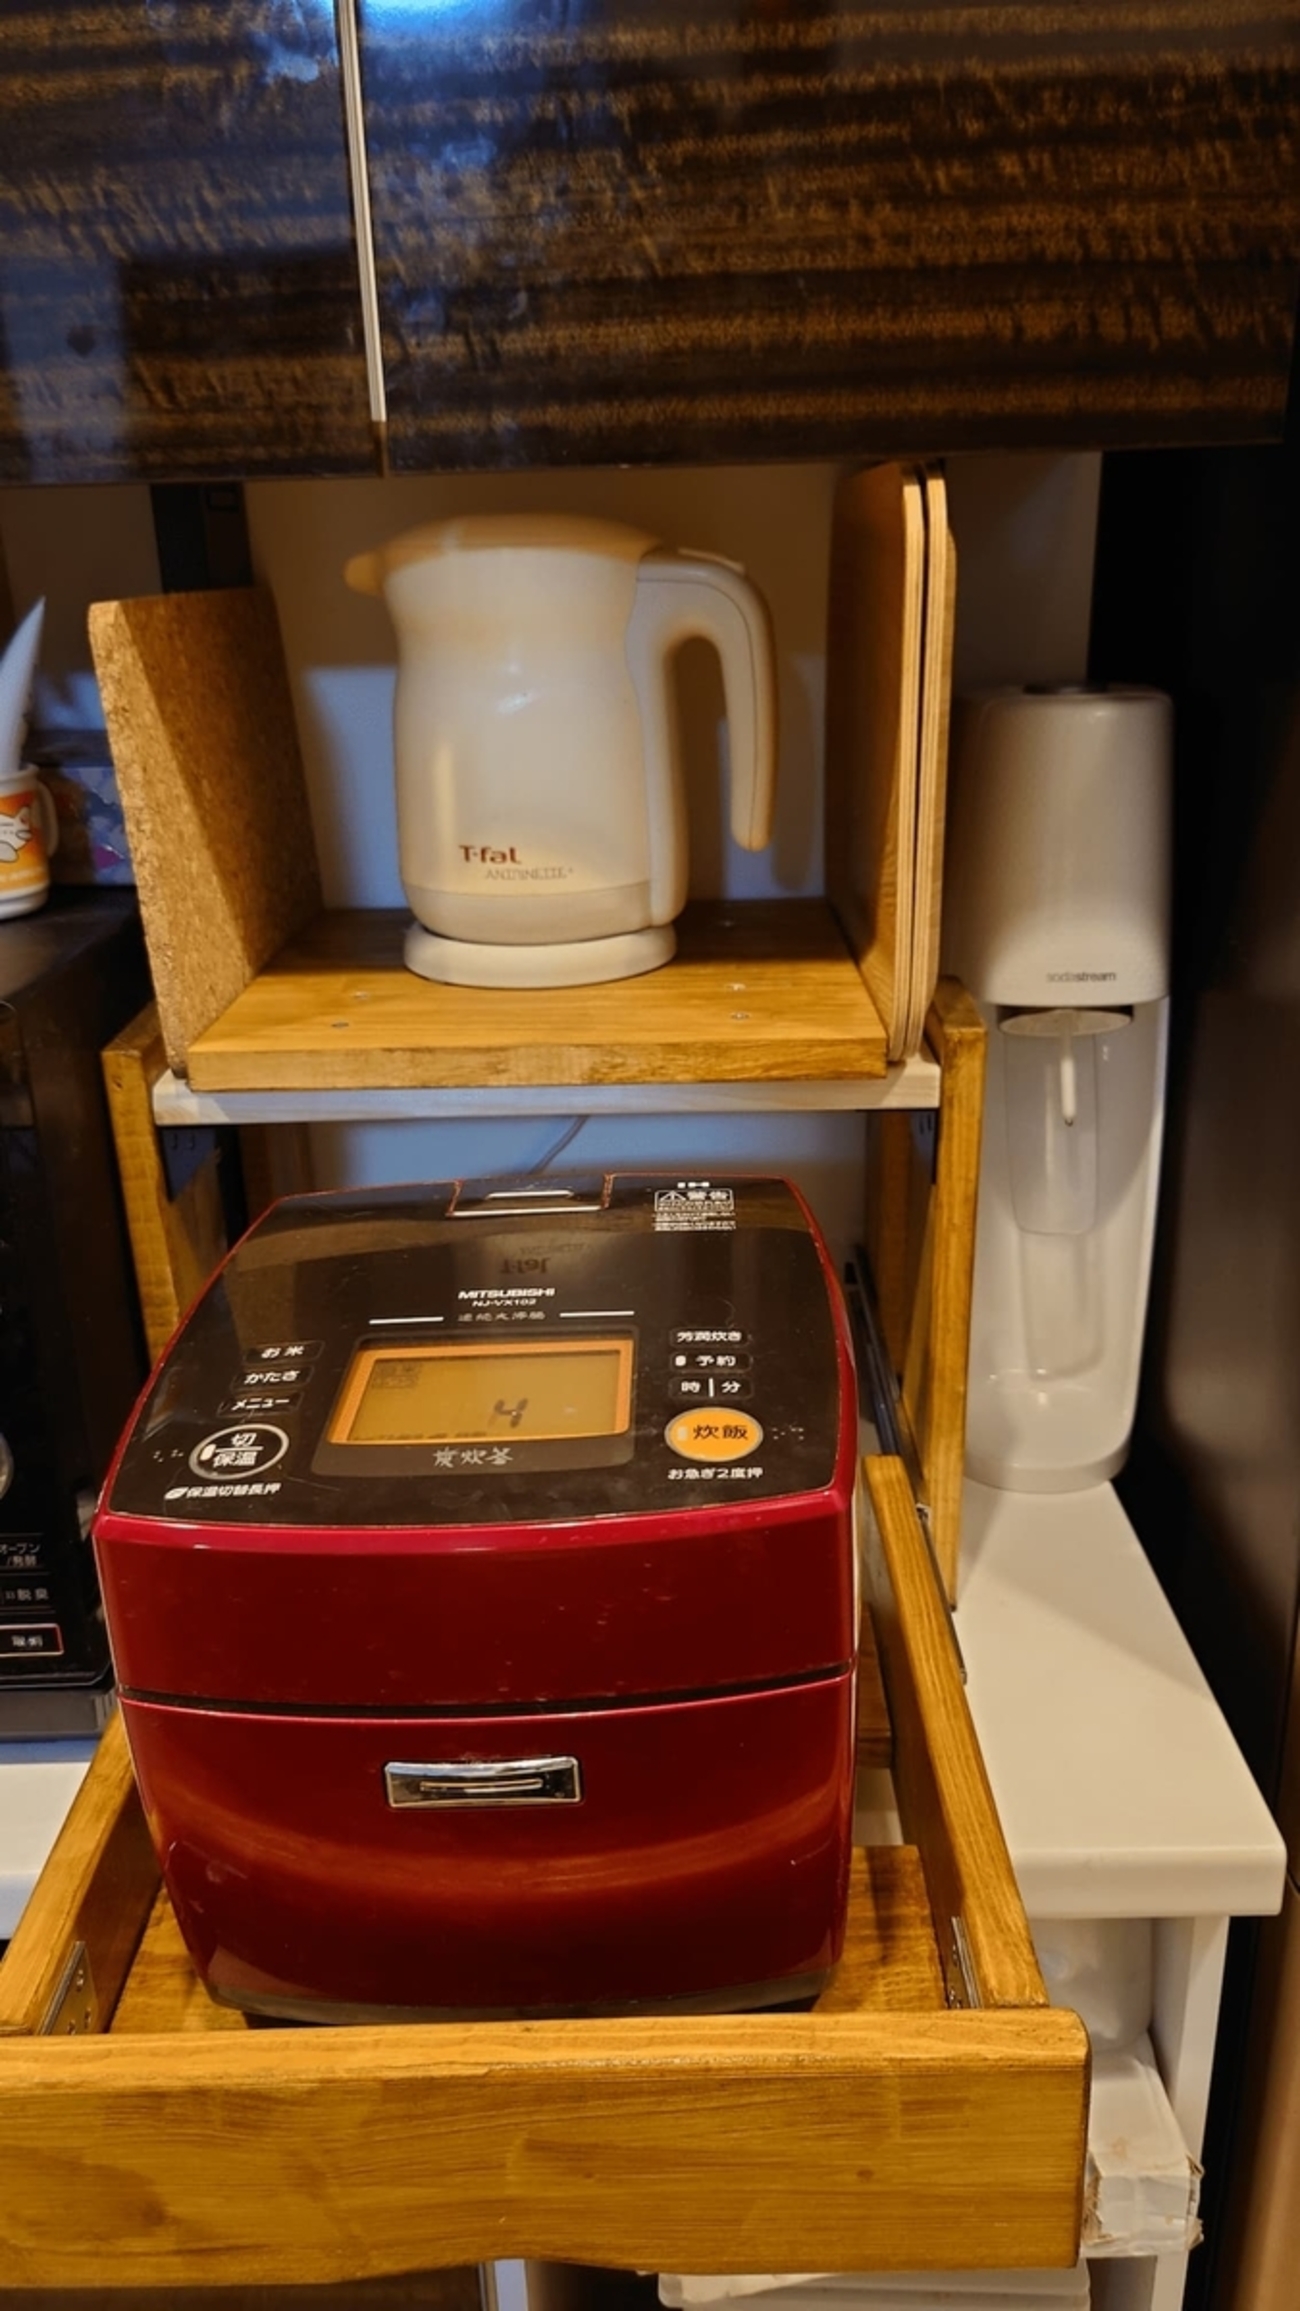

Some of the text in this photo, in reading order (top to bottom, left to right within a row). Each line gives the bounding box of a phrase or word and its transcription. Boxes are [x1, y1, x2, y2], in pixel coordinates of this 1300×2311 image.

[458, 1287, 556, 1300] MITSUBISHI
[261, 1345, 305, 1359] お米
[695, 1354, 737, 1367] 予約
[243, 1370, 301, 1385] かたさ
[680, 1380, 742, 1393] 時 分
[231, 1397, 290, 1411] メニュー
[230, 1432, 257, 1446] 切
[692, 1423, 749, 1441] 炊飯
[213, 1451, 258, 1468] 保温
[667, 1466, 764, 1481] お急ぎ2度押
